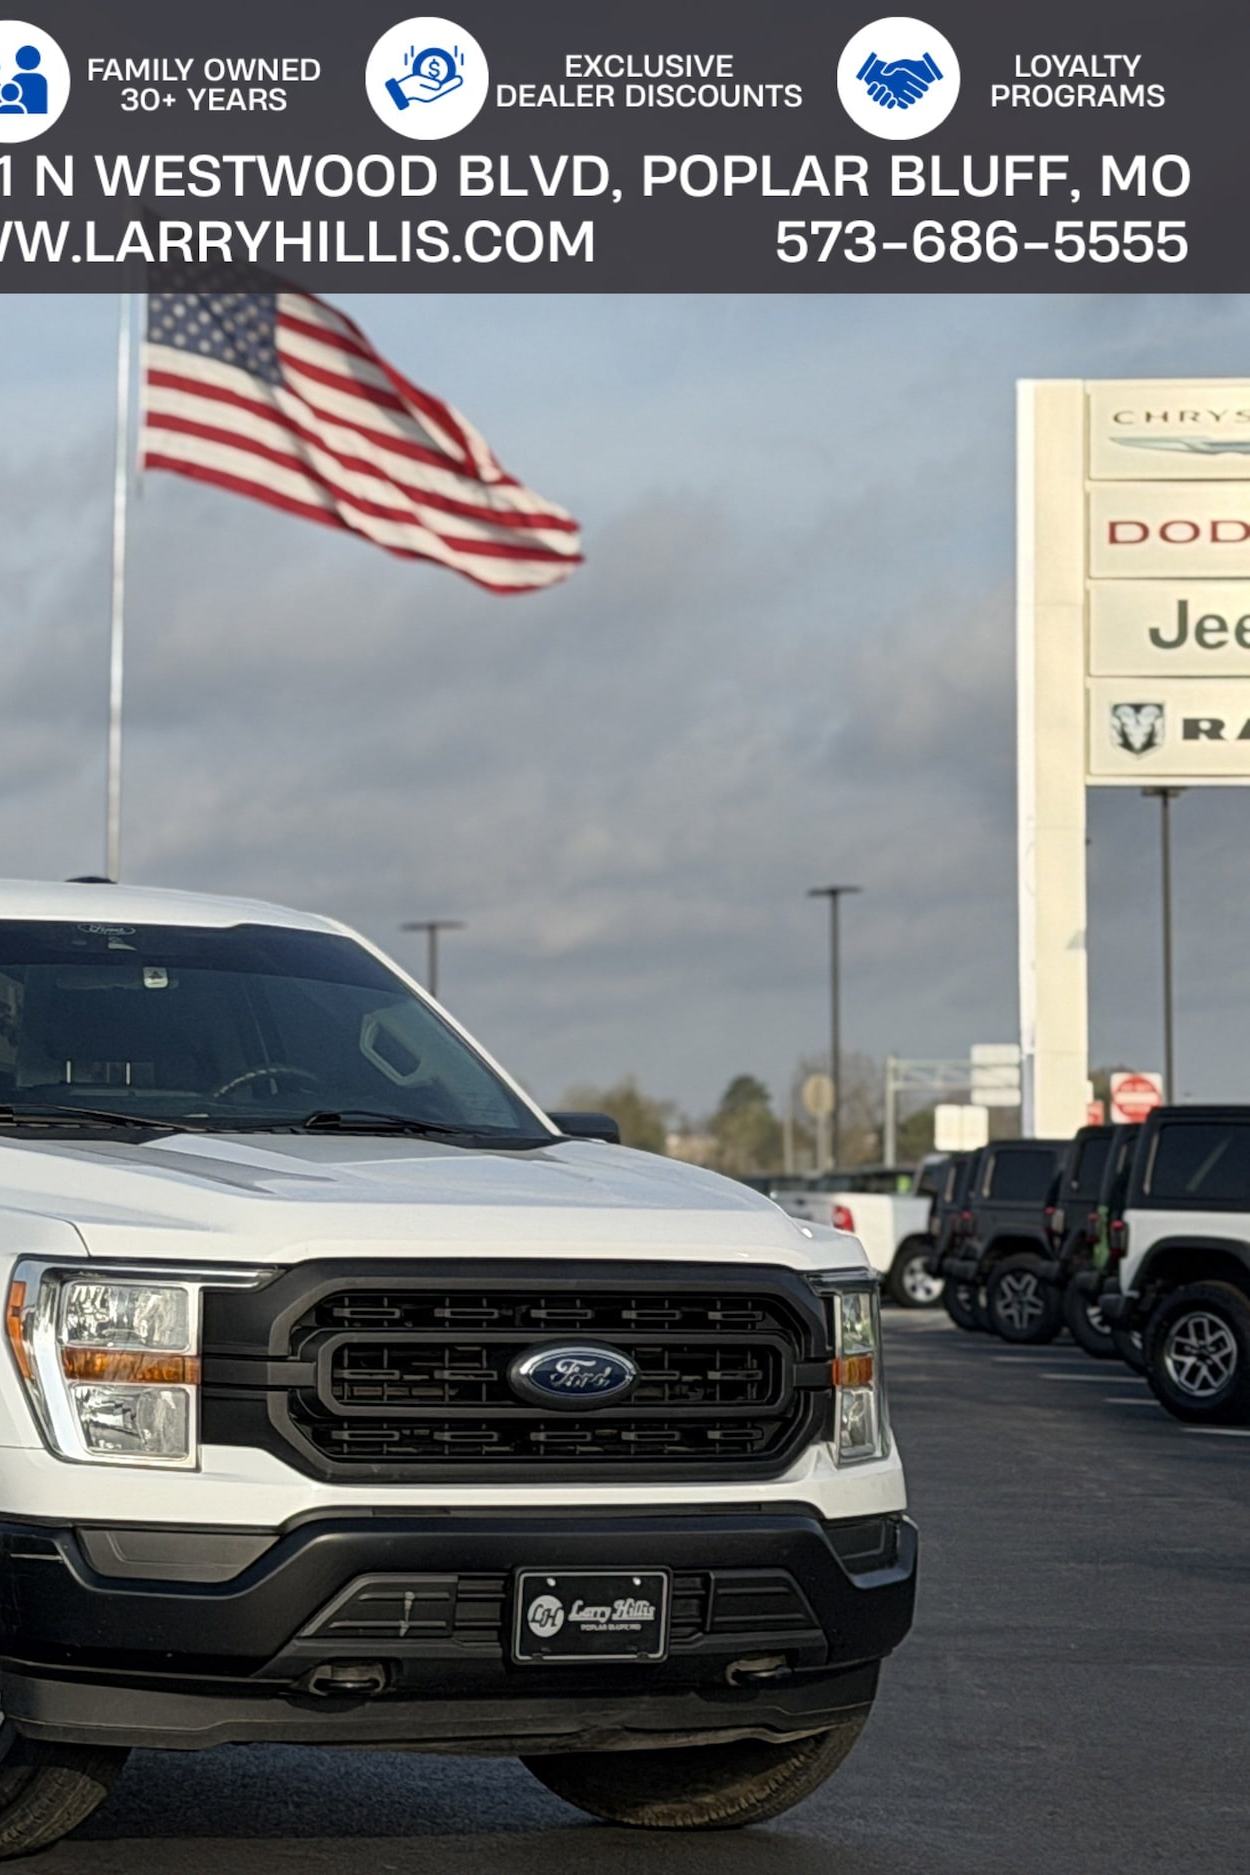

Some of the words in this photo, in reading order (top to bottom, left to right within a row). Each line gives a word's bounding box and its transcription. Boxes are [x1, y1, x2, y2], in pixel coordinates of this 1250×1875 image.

[1108, 520, 1250, 545] DOD
[550, 1359, 612, 1388] Ford
[568, 1599, 611, 1623] Larry
[611, 1598, 656, 1621] Hillis
